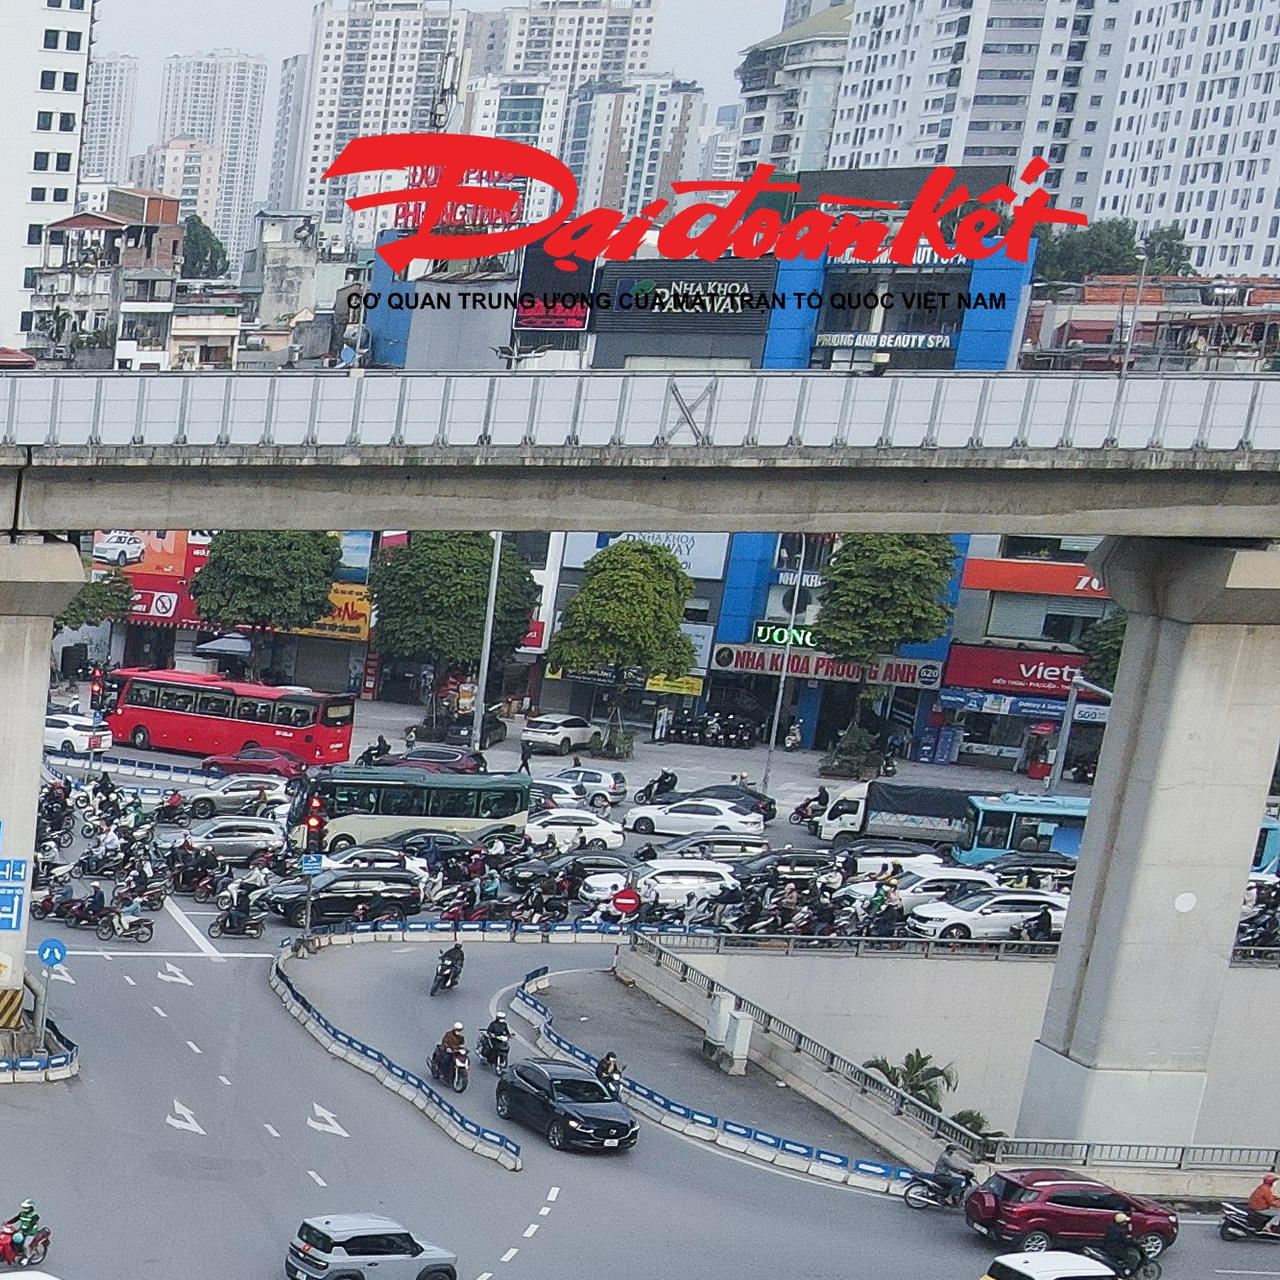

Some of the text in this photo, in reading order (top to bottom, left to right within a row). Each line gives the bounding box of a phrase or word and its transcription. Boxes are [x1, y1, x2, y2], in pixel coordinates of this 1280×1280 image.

[879, 335, 923, 348] BEAUTY
[927, 335, 951, 348] SPA
[734, 650, 765, 671] NHA
[882, 663, 917, 684] ANH
